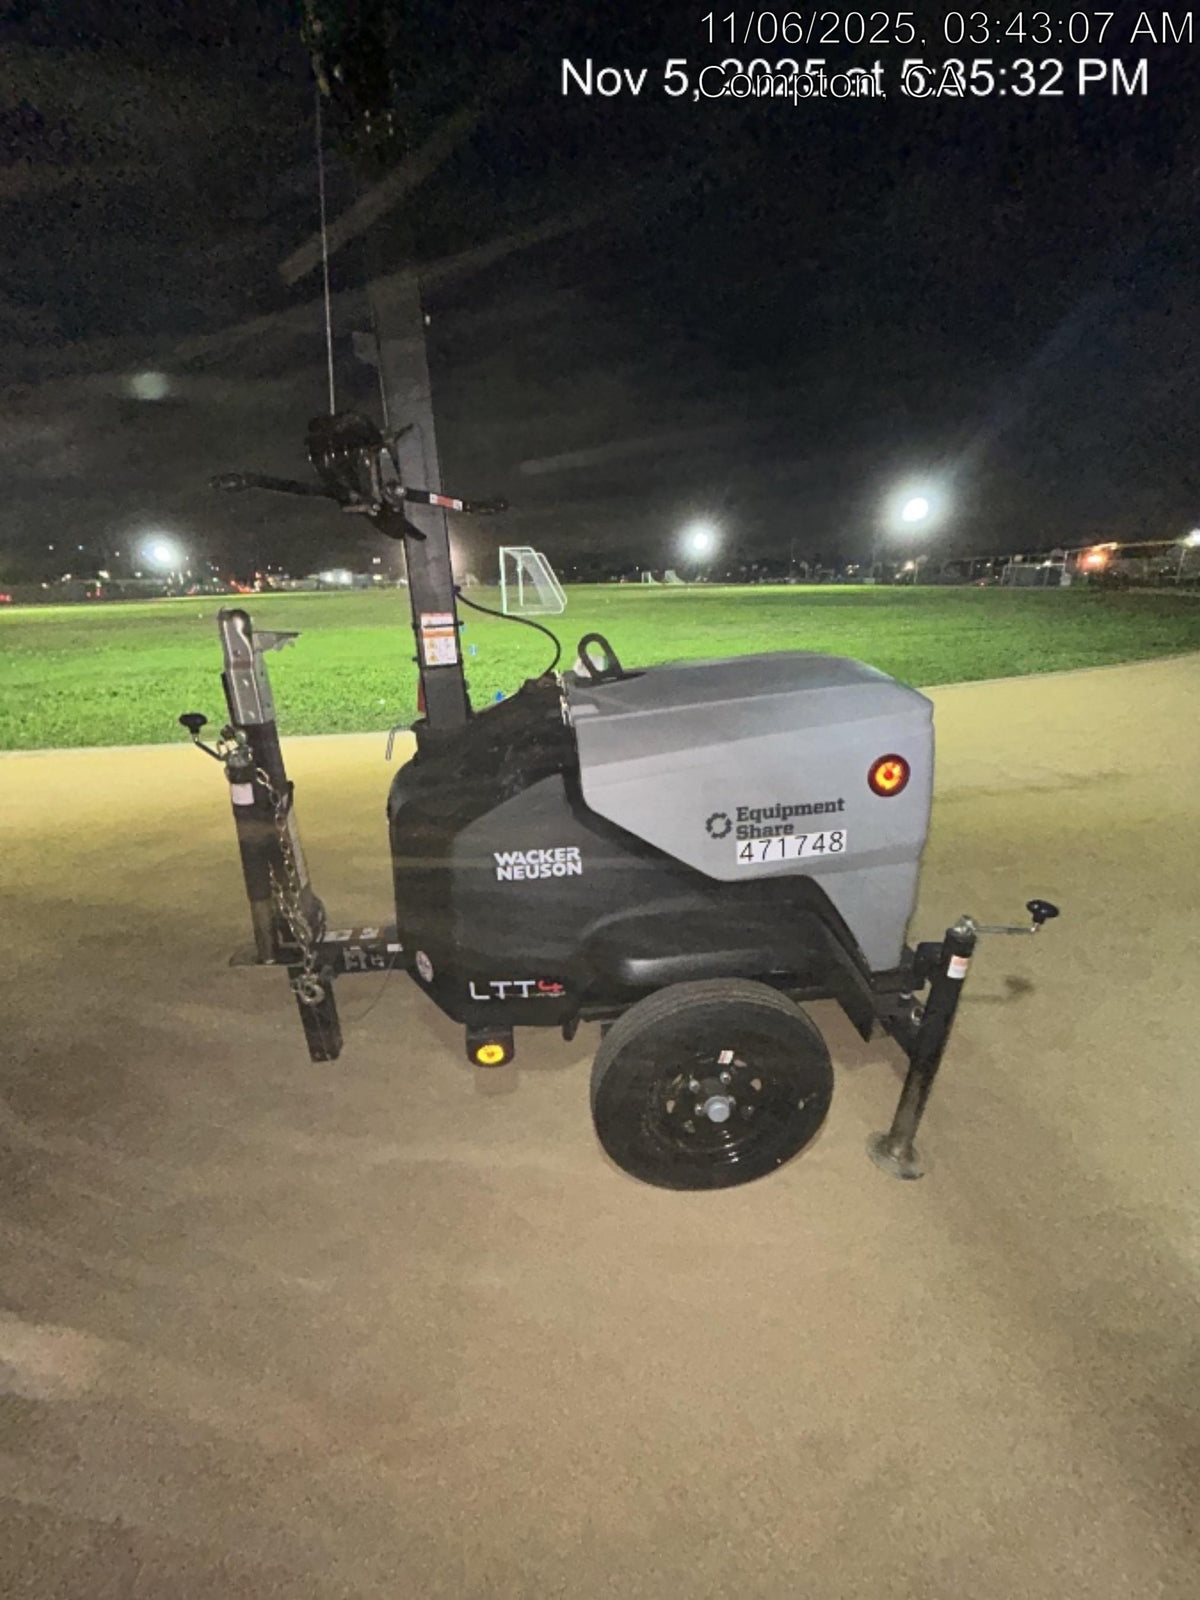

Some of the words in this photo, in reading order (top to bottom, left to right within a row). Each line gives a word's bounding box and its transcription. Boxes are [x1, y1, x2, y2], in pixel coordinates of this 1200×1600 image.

[735, 798, 845, 824] Equipment
[735, 823, 794, 841] Share
[494, 846, 581, 868] WACKER
[739, 830, 845, 862] 471748
[496, 861, 583, 881] NEUSON
